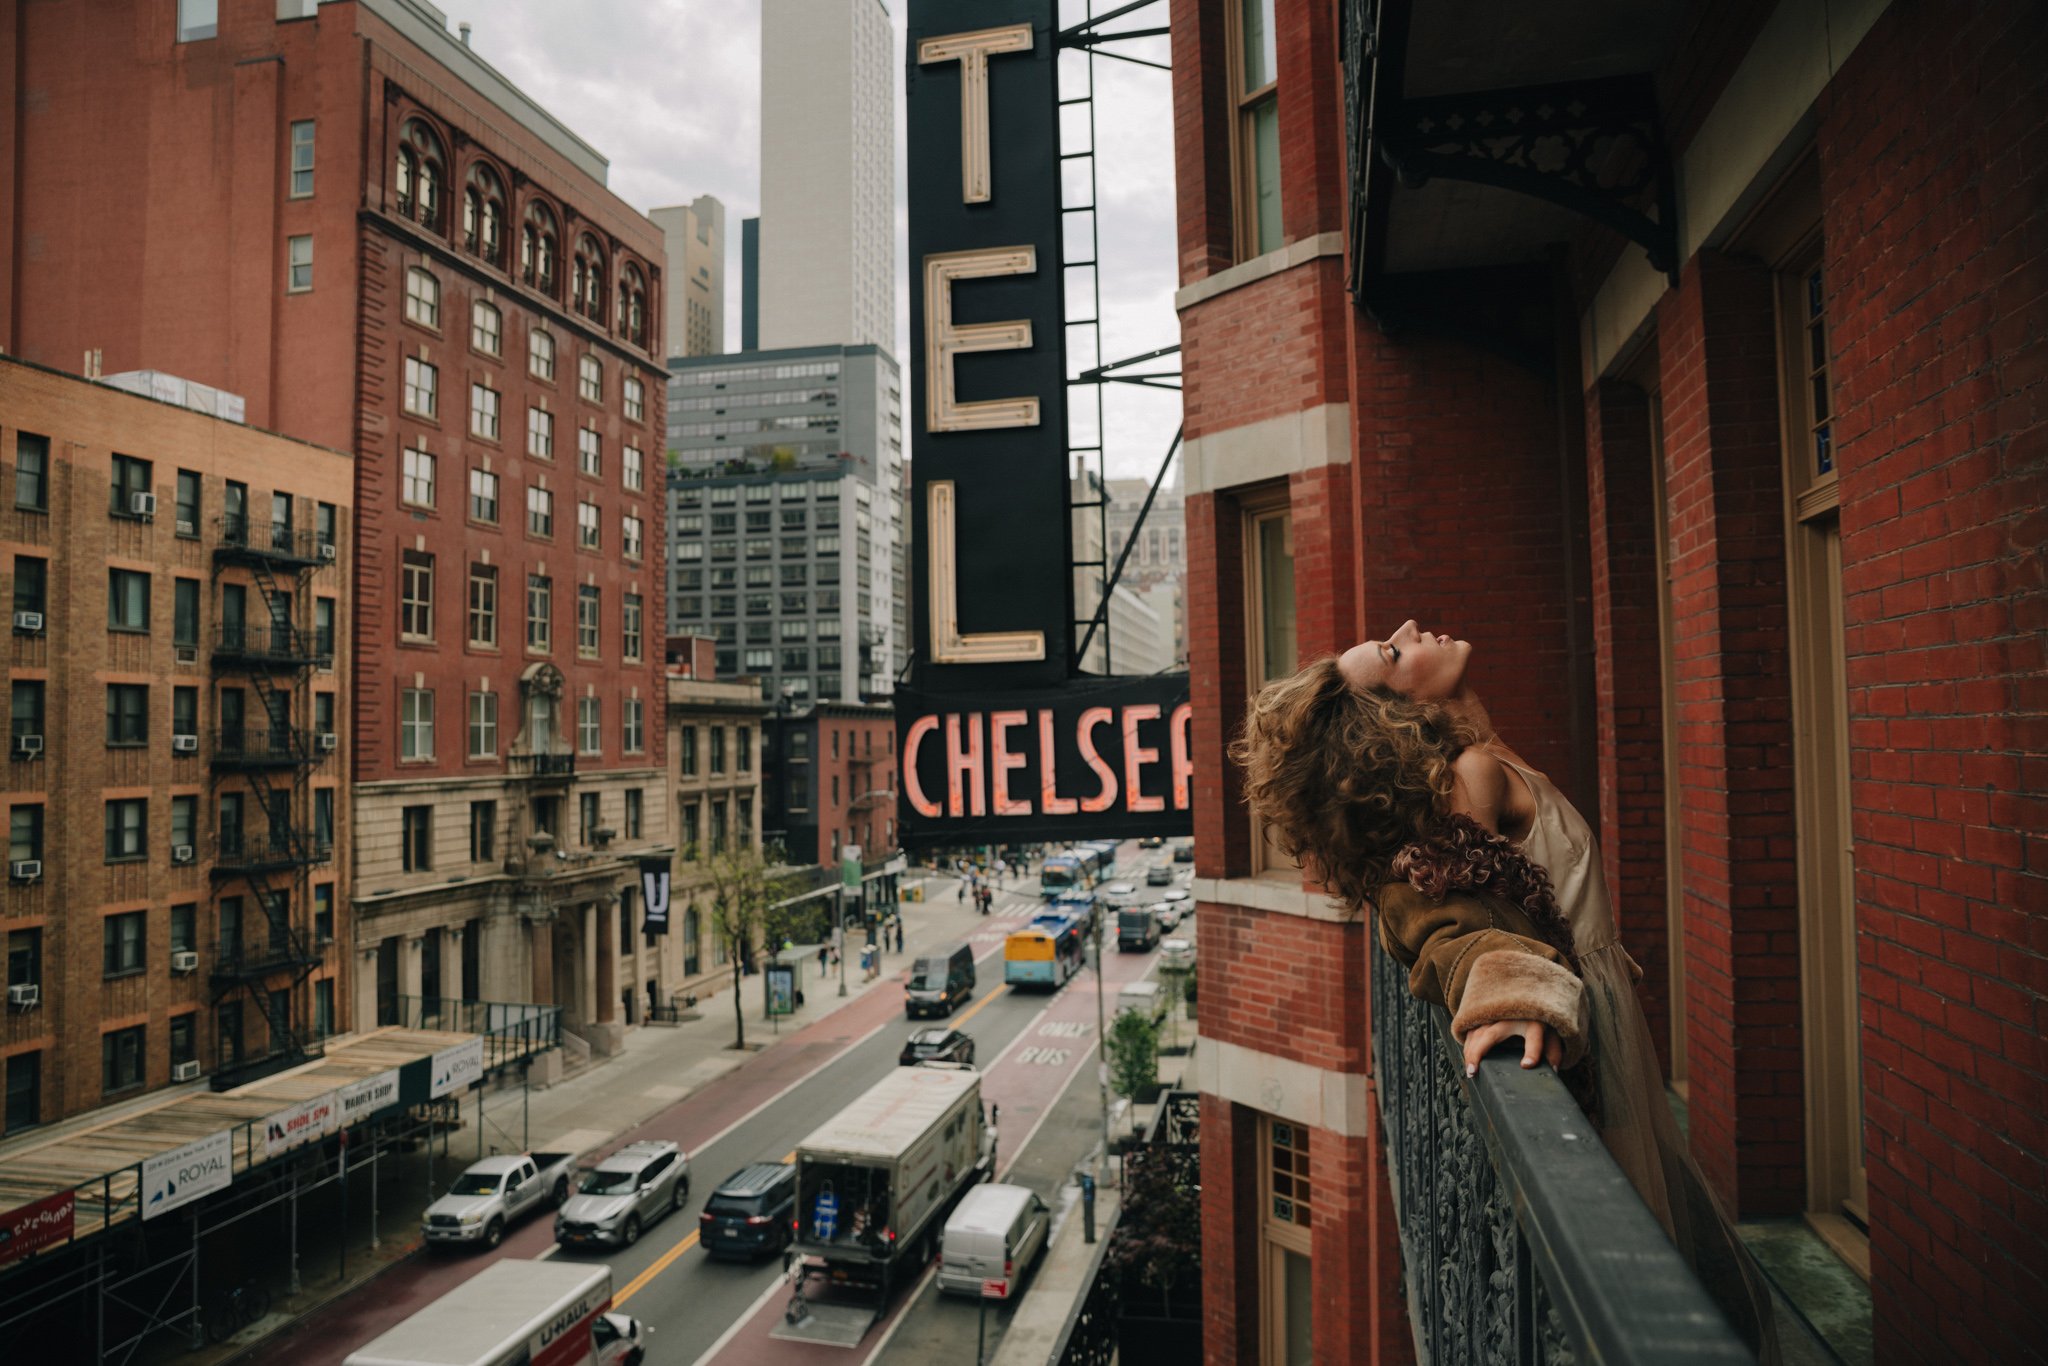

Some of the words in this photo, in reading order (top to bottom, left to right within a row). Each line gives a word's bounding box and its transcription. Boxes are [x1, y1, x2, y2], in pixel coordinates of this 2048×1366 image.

[1038, 1021, 1096, 1037] ONLY
[1014, 1046, 1072, 1066] BUS
[374, 1083, 394, 1100] SHOP
[286, 1113, 310, 1132] SHOE
[313, 1105, 330, 1121] SPA
[178, 1155, 227, 1185] ROYAL
[541, 1300, 591, 1347] U-HAUL
